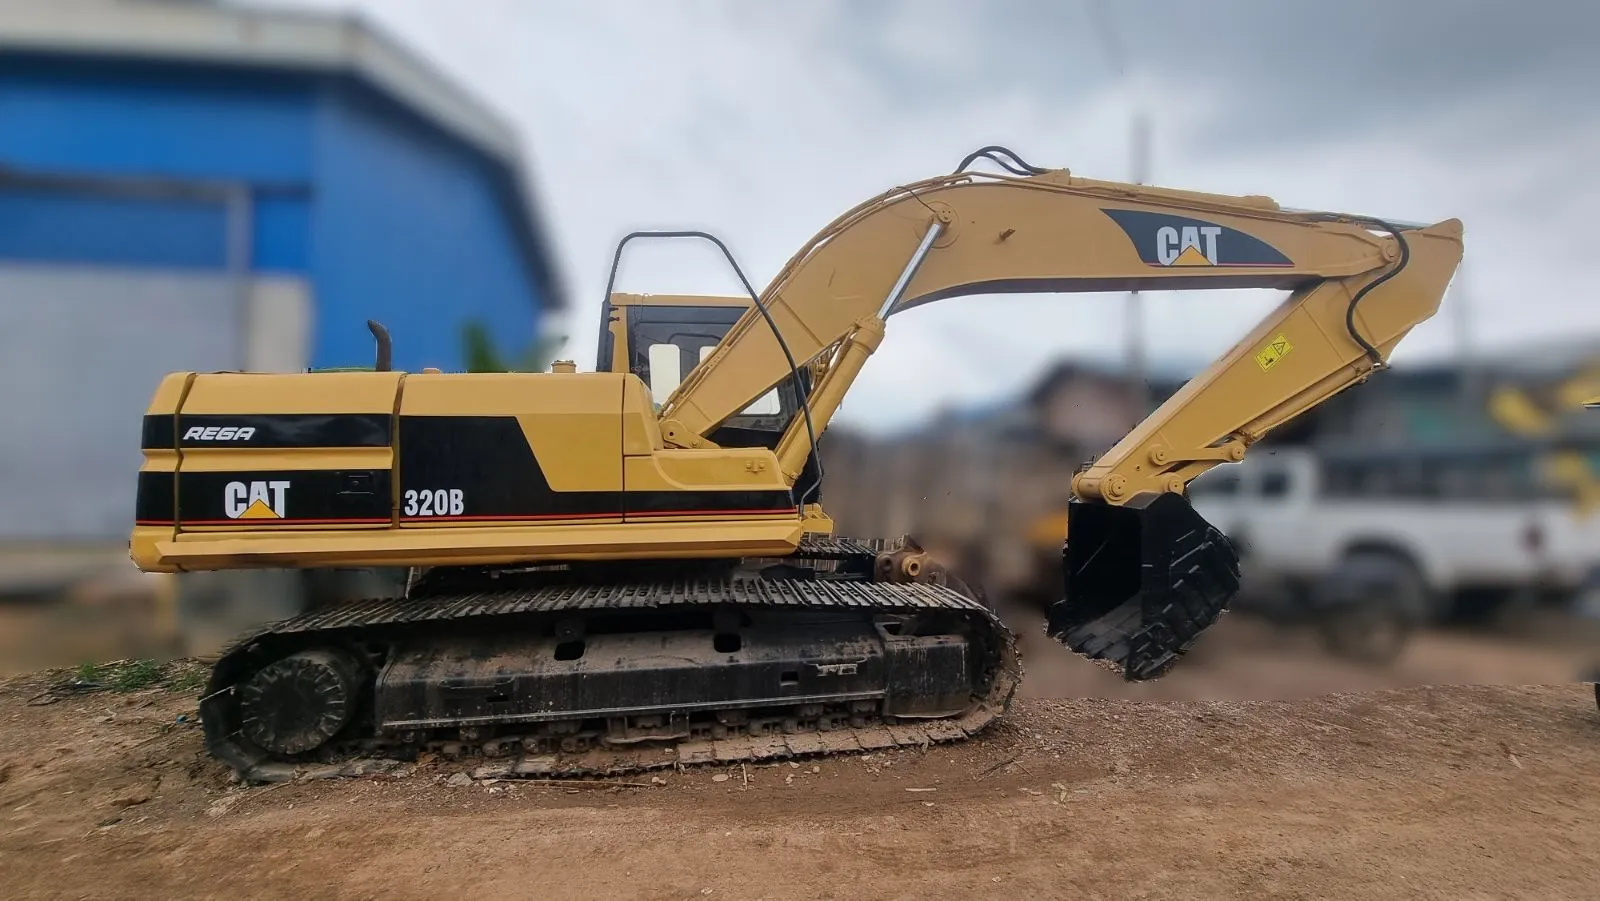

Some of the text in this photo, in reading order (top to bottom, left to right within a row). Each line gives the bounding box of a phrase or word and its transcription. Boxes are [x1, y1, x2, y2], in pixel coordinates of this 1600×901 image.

[1157, 226, 1221, 266] CAT
[183, 426, 256, 441] REGA
[224, 481, 290, 519] CAT
[404, 489, 465, 516] 320B
